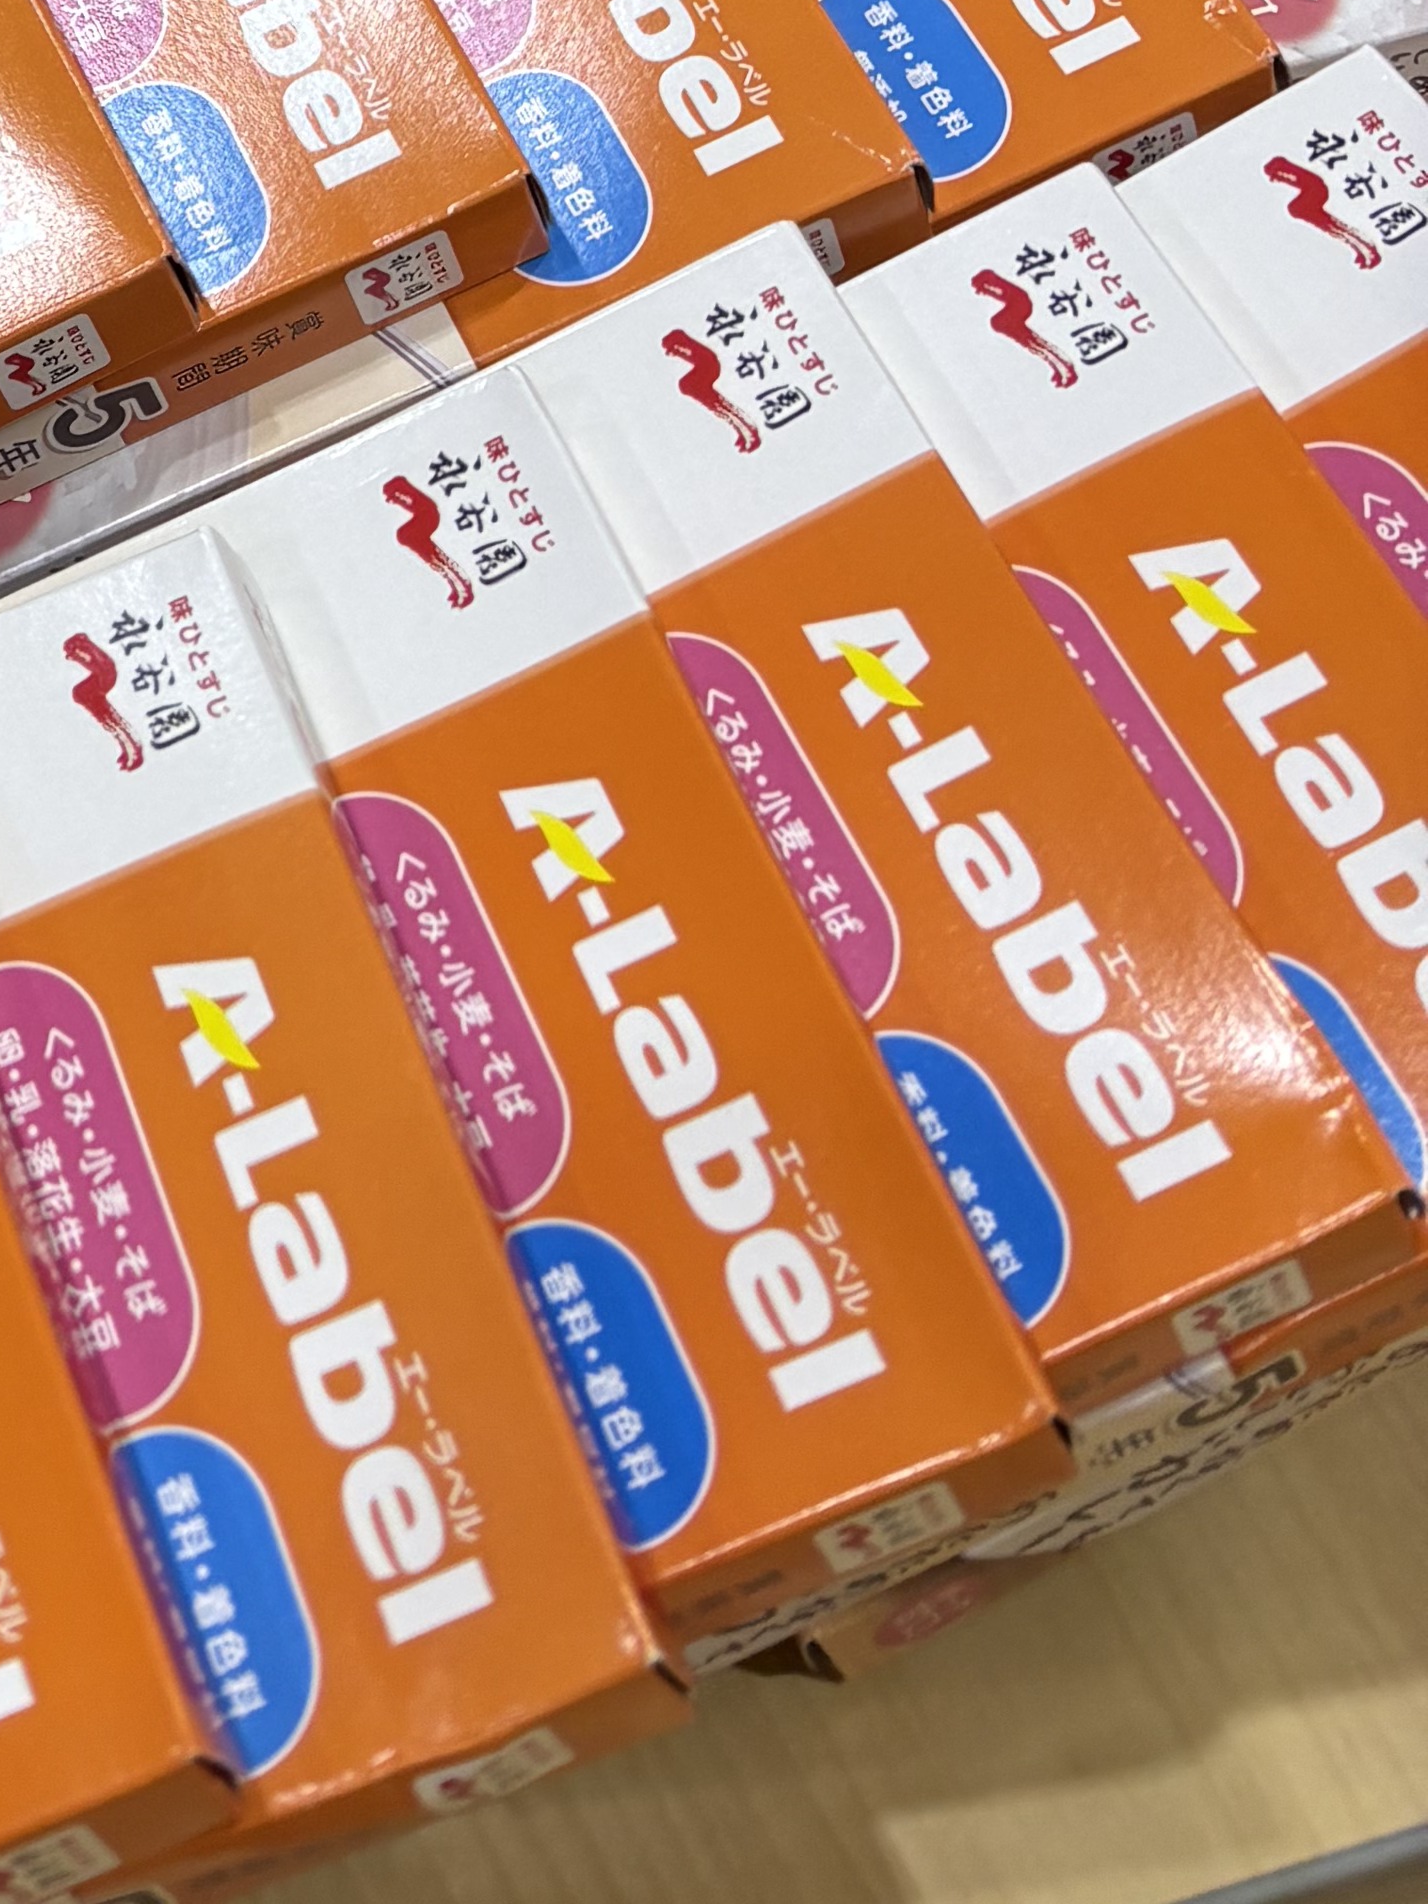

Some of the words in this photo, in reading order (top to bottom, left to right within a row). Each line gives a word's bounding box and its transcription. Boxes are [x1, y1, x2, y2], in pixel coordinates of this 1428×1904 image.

[864, 0, 973, 140] 香料・着色料
[801, 609, 1233, 1202] A-Label
[1129, 537, 1428, 1024] A-Lab
[152, 957, 495, 1648] A-Label
[498, 778, 887, 1413] A-Label
